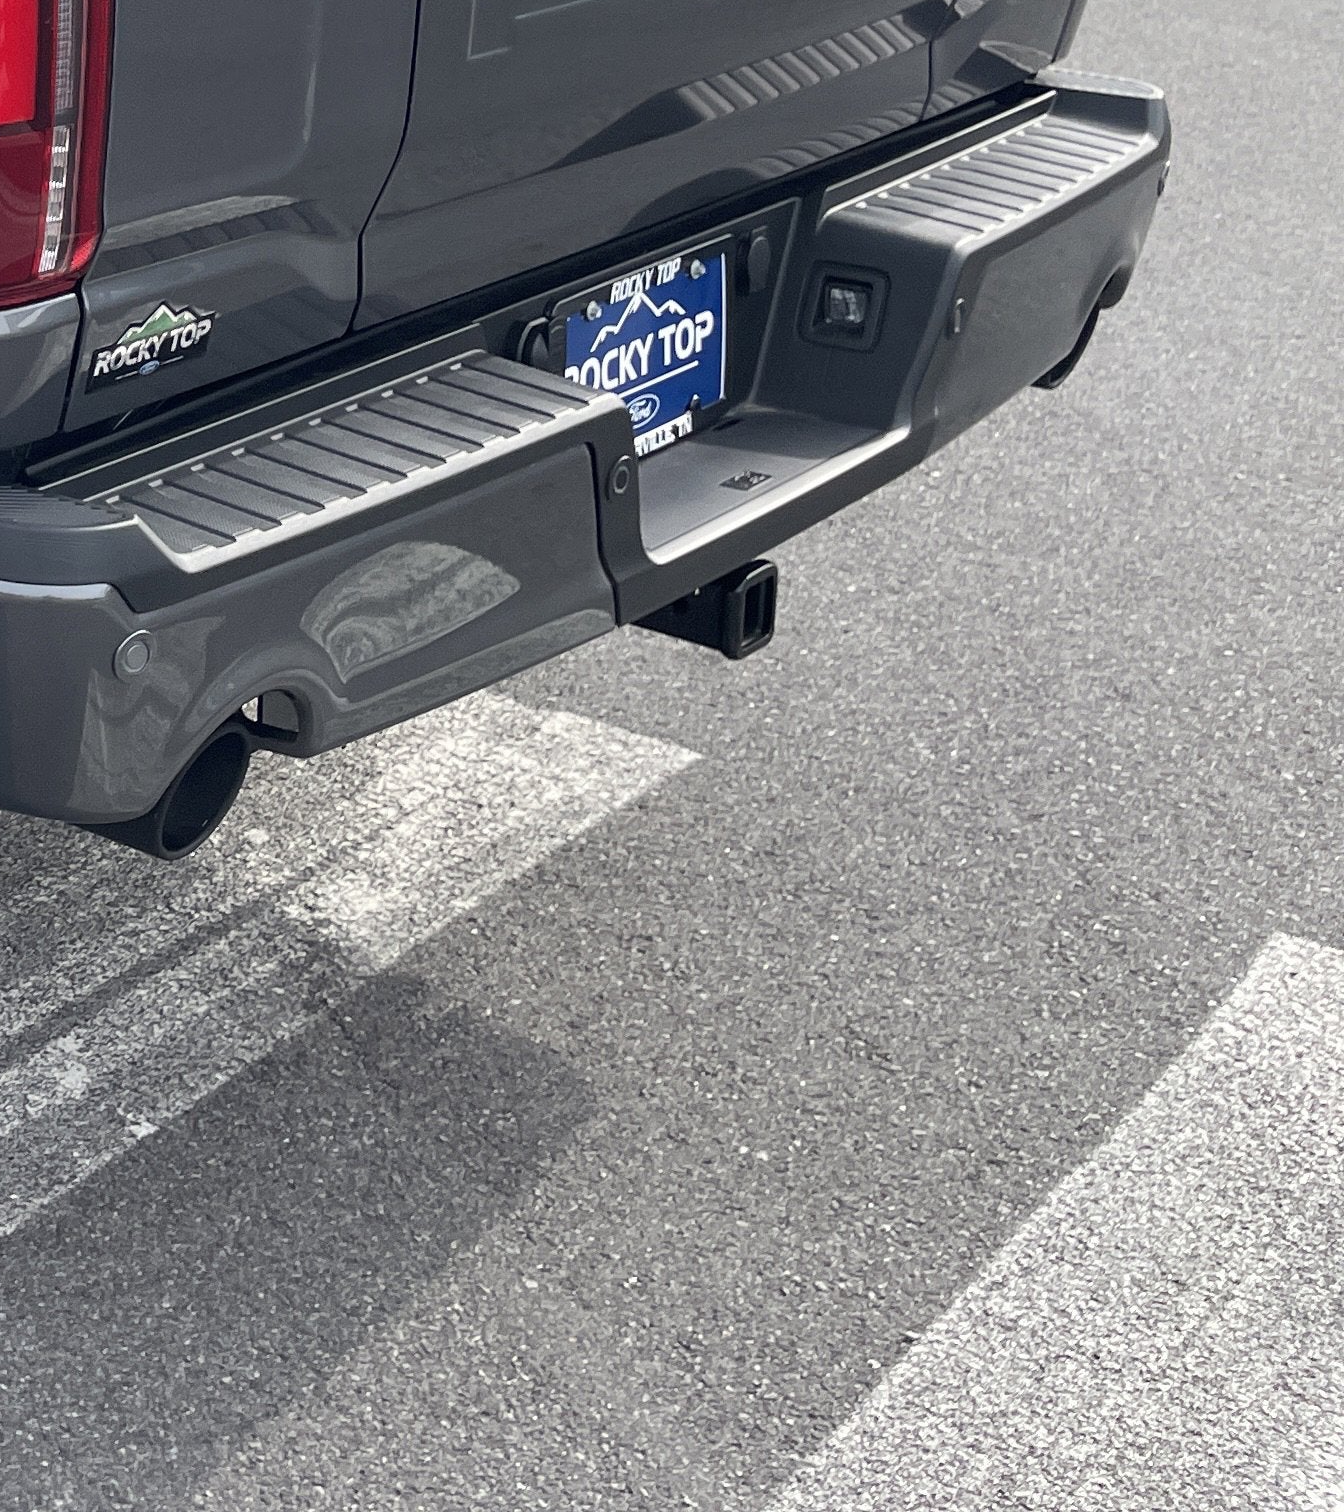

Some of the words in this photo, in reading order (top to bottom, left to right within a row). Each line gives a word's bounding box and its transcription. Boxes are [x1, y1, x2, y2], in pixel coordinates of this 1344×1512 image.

[610, 265, 654, 305] ROCKY
[656, 256, 682, 286] TOP
[93, 332, 168, 377] ROCKY
[170, 319, 212, 352] TOP
[658, 310, 714, 367] TOP
